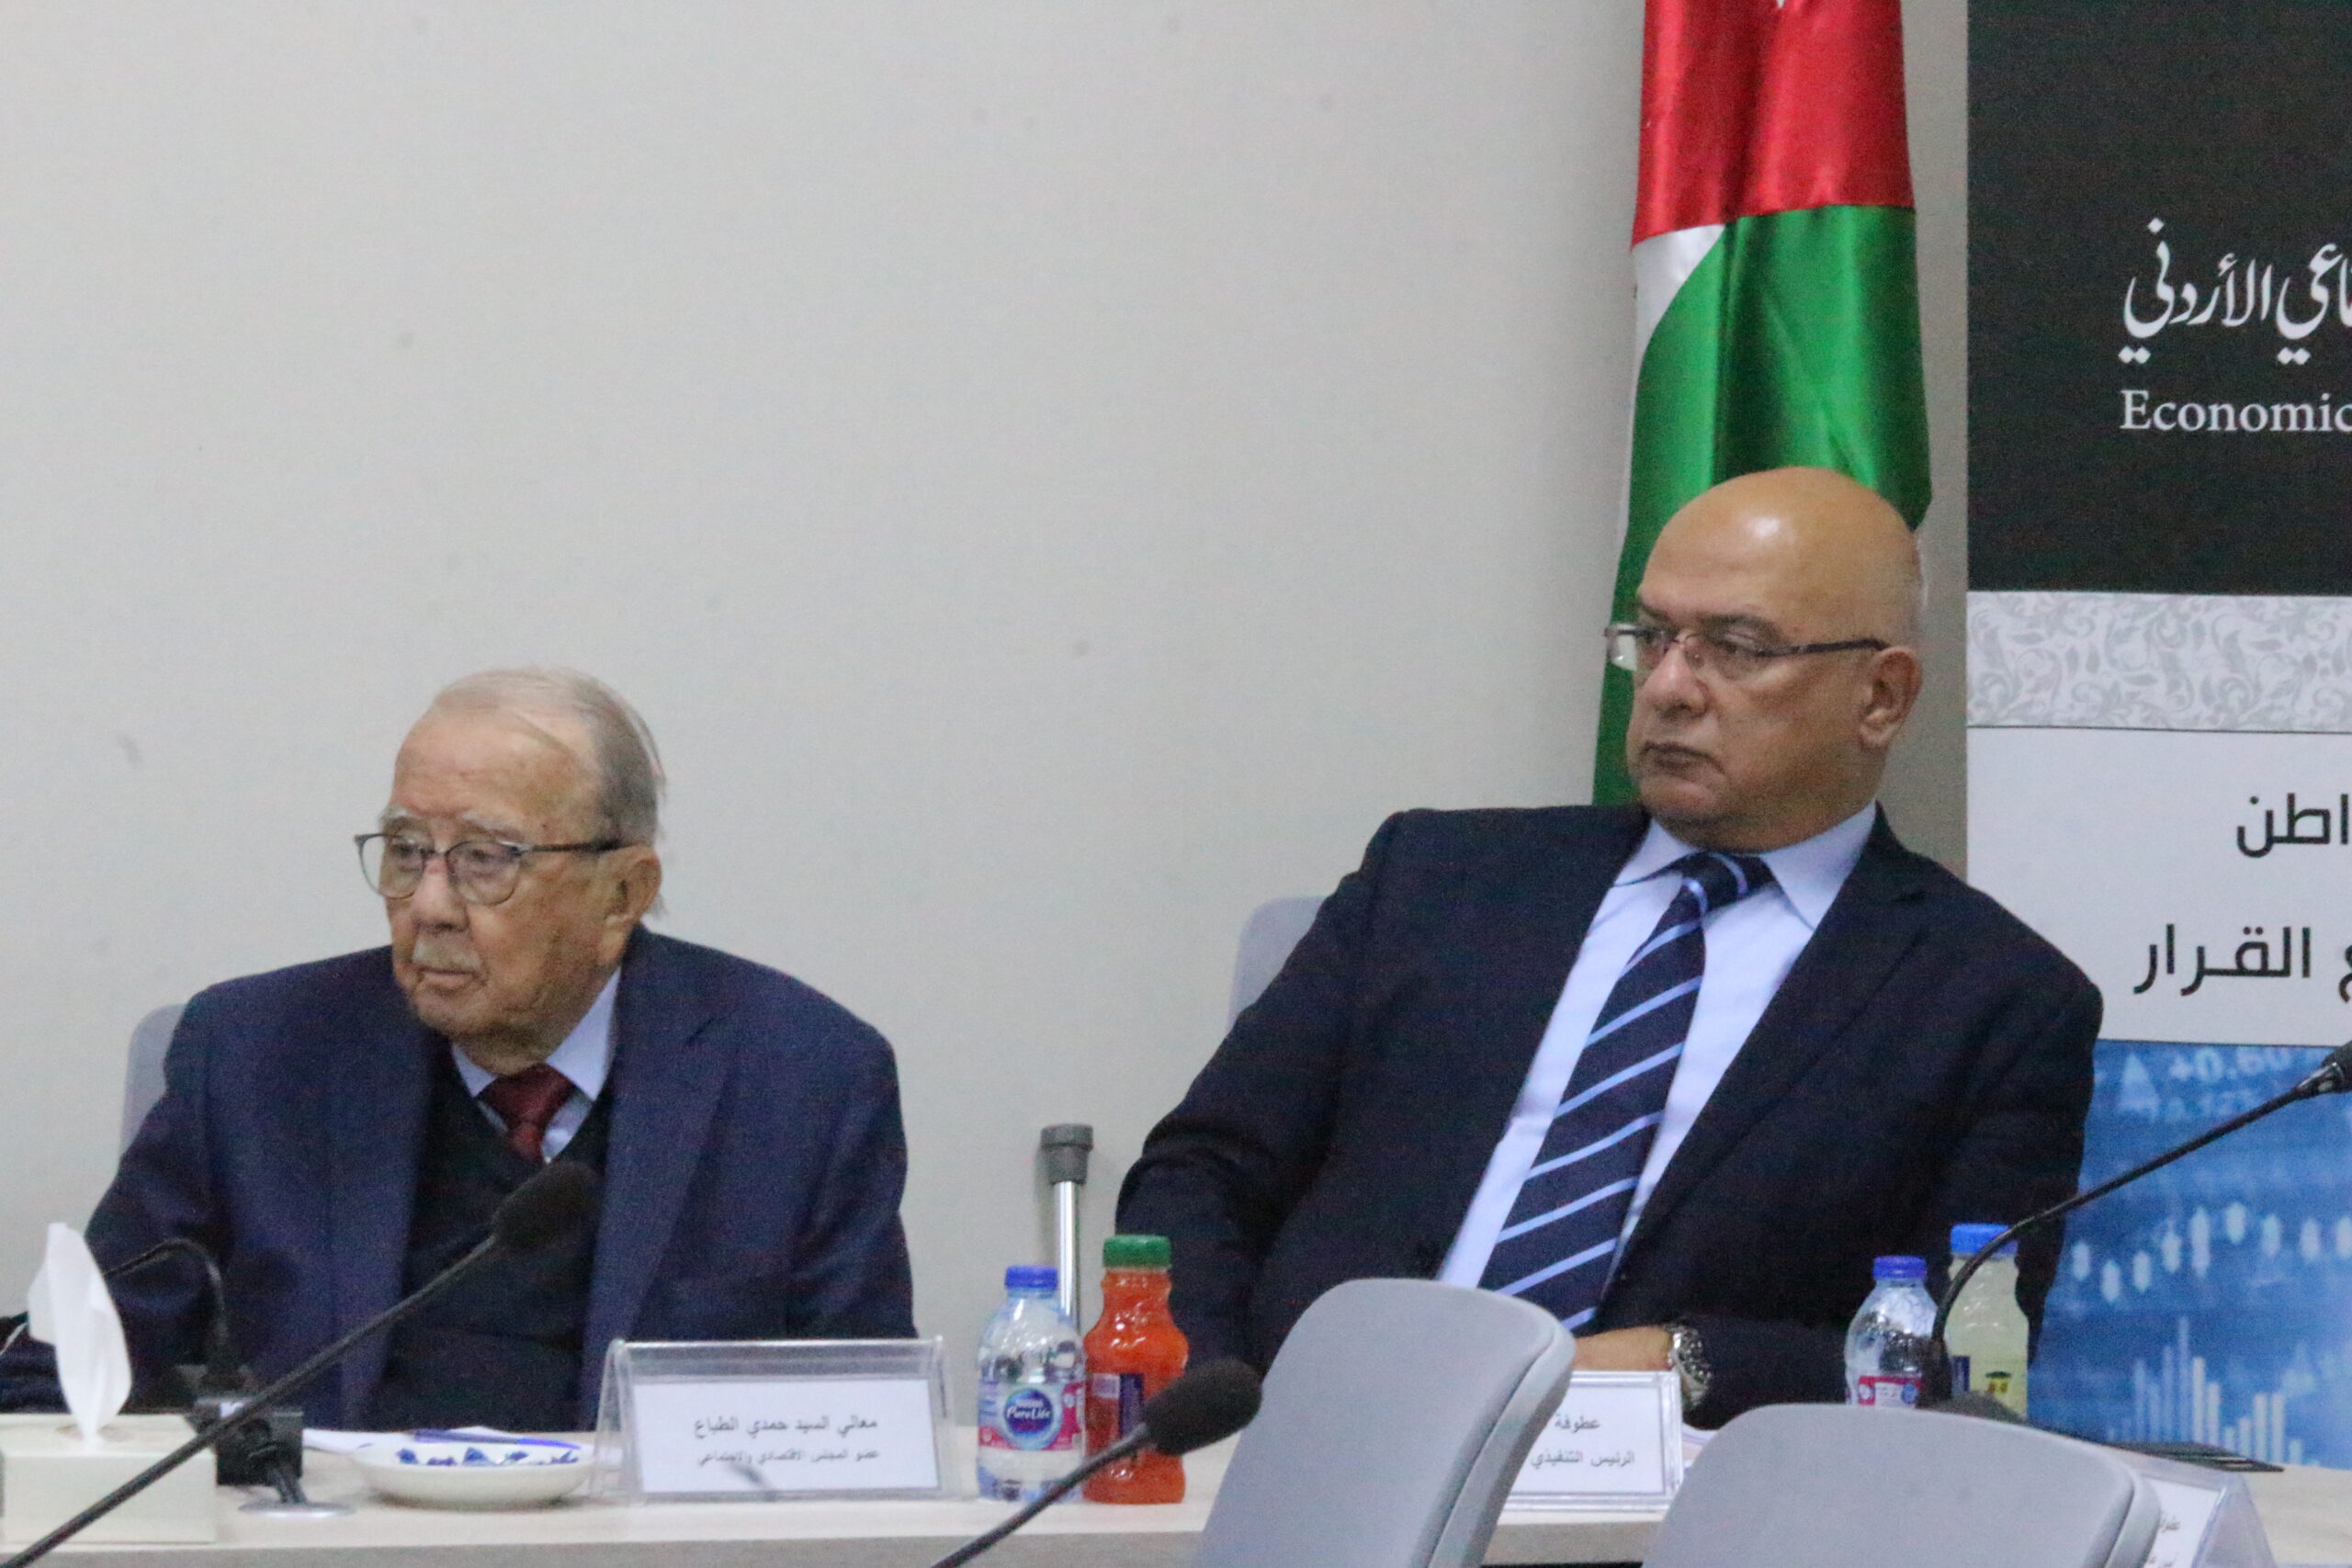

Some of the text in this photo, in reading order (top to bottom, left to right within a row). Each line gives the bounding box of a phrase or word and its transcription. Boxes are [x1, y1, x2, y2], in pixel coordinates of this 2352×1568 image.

[2118, 217, 2273, 365] الأردني
[2120, 389, 2352, 433] Economic
[2133, 923, 2311, 997] القرار
[695, 1415, 878, 1439] معالي السيد حمدي الطباع
[1555, 1414, 1600, 1434] عطوفة
[1531, 1449, 1635, 1471] الرئيس التنفيذي
